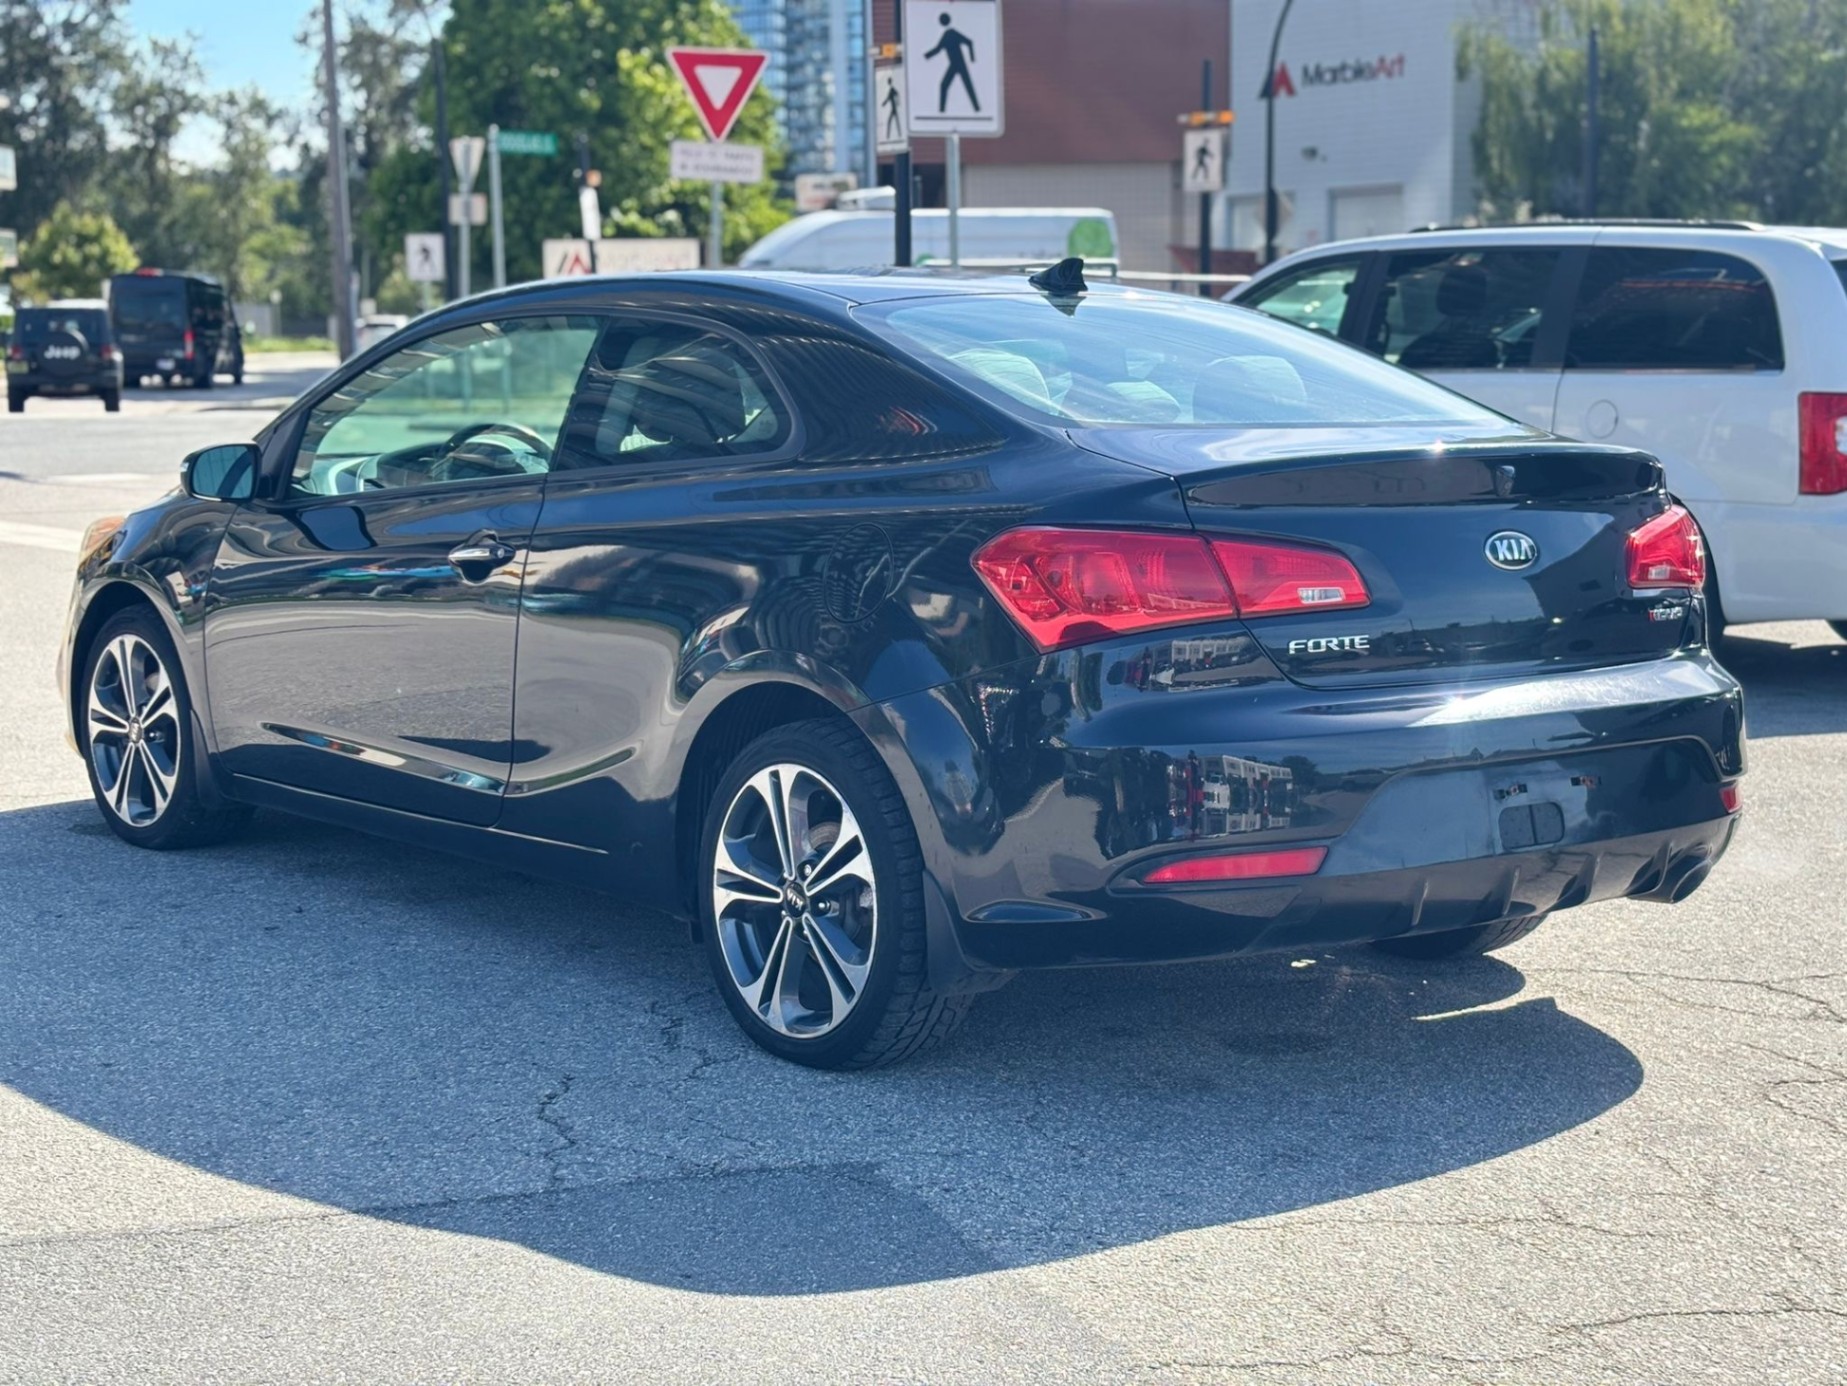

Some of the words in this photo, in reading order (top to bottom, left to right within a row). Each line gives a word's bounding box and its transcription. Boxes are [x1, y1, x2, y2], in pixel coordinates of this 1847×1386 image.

[44, 345, 81, 360] Jeep
[1493, 538, 1533, 561] KIA
[1288, 634, 1371, 655] FORTE
[786, 887, 804, 911] KIA
